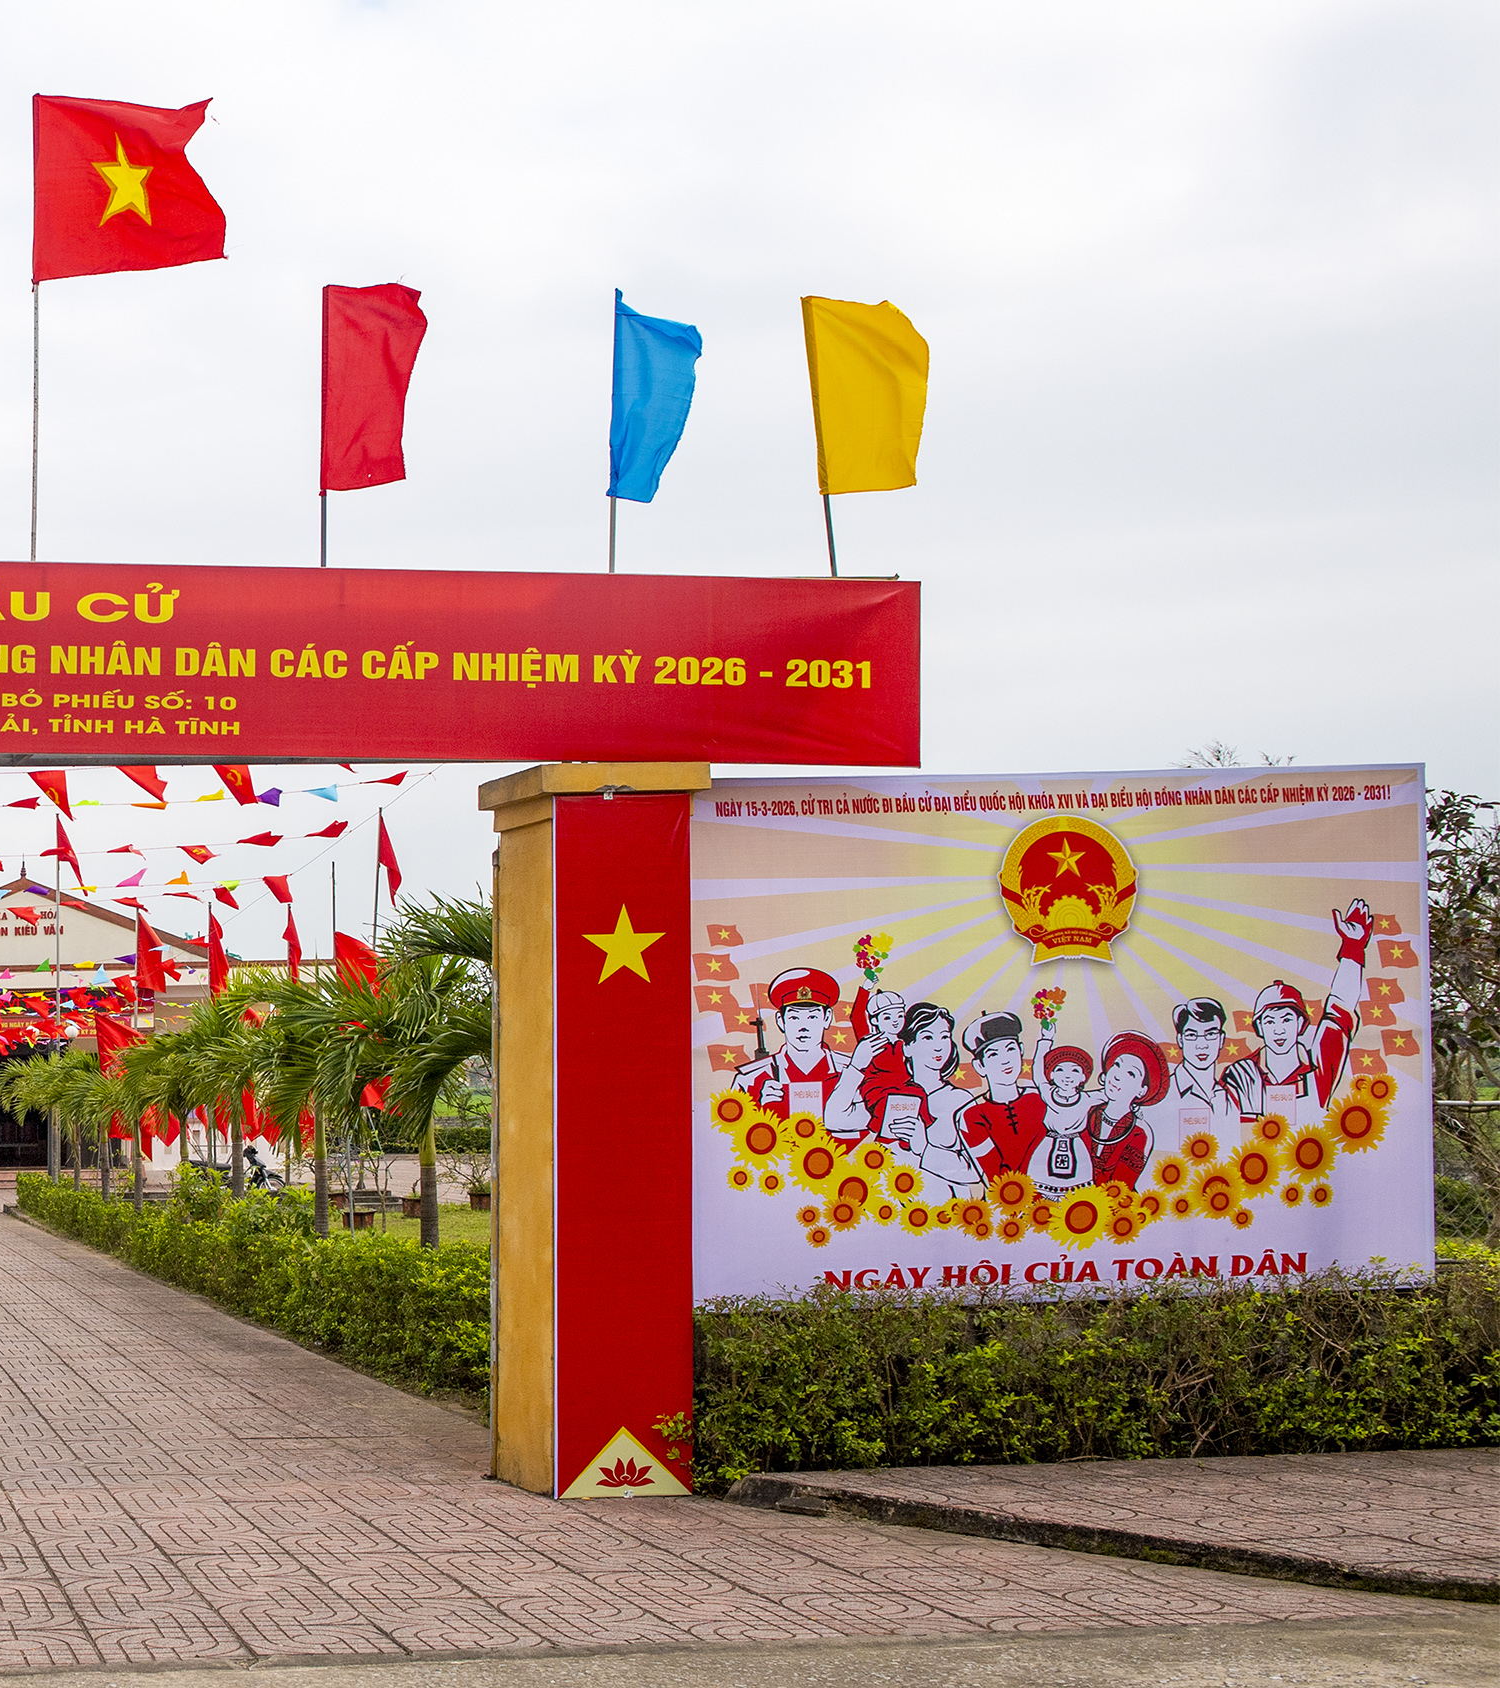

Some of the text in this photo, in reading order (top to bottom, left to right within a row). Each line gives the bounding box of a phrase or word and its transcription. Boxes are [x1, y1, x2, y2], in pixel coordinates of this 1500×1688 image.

[76, 581, 181, 624] CỬ
[51, 640, 160, 675] NHÂN
[176, 642, 255, 677] DÂN
[271, 643, 347, 678] CÁC
[362, 641, 439, 679] CẤP
[453, 648, 579, 688] NHIỆM
[594, 649, 641, 683] KỲ
[654, 656, 746, 686] 2026
[759, 670, 773, 678] -
[786, 658, 871, 689] 2031
[1, 688, 43, 708] BỎ
[53, 689, 135, 709] PHIẾU
[145, 690, 193, 709] SỐ:
[205, 696, 237, 711] 10
[49, 714, 114, 733] TỈNH
[125, 716, 166, 734] HÀ
[175, 717, 240, 735] TĨNH
[716, 801, 742, 817] NGÀY
[746, 801, 799, 817] 15-3-2026,
[801, 793, 815, 815] CỬ
[817, 799, 833, 815] TRI
[836, 793, 850, 814] CẢ
[852, 794, 879, 814] NƯỚC
[882, 798, 893, 813] ĐI
[895, 792, 915, 813] BẦU
[918, 791, 932, 812] CỬ
[934, 797, 951, 815] ĐẠI
[954, 790, 976, 811] BIỂU
[979, 790, 1006, 812] QUỐC
[1008, 792, 1025, 813] HỘI
[1028, 791, 1055, 809] KHÓA
[1057, 793, 1073, 809] XVI
[1077, 790, 1090, 808] VÀ
[1091, 793, 1108, 811] ĐẠI
[1110, 786, 1133, 808] BIỂU
[1135, 788, 1152, 809] HỘI
[1154, 786, 1182, 806] ĐỒNG
[1184, 788, 1212, 805] NHÂN
[1214, 788, 1235, 804] DÂN
[1237, 787, 1257, 804] CÁC
[1260, 783, 1280, 803] CẤP
[1282, 784, 1314, 805] NHIỆM
[1316, 784, 1329, 802] KỲ
[1332, 786, 1355, 801] 2026
[1364, 785, 1391, 800] 2031!
[1052, 934, 1092, 944] VIỆT NAM
[823, 1263, 932, 1292] NGÀY
[1023, 1254, 1100, 1284] CỦA
[1112, 1251, 1218, 1281] TOÀN
[1230, 1248, 1308, 1277] DÂN
